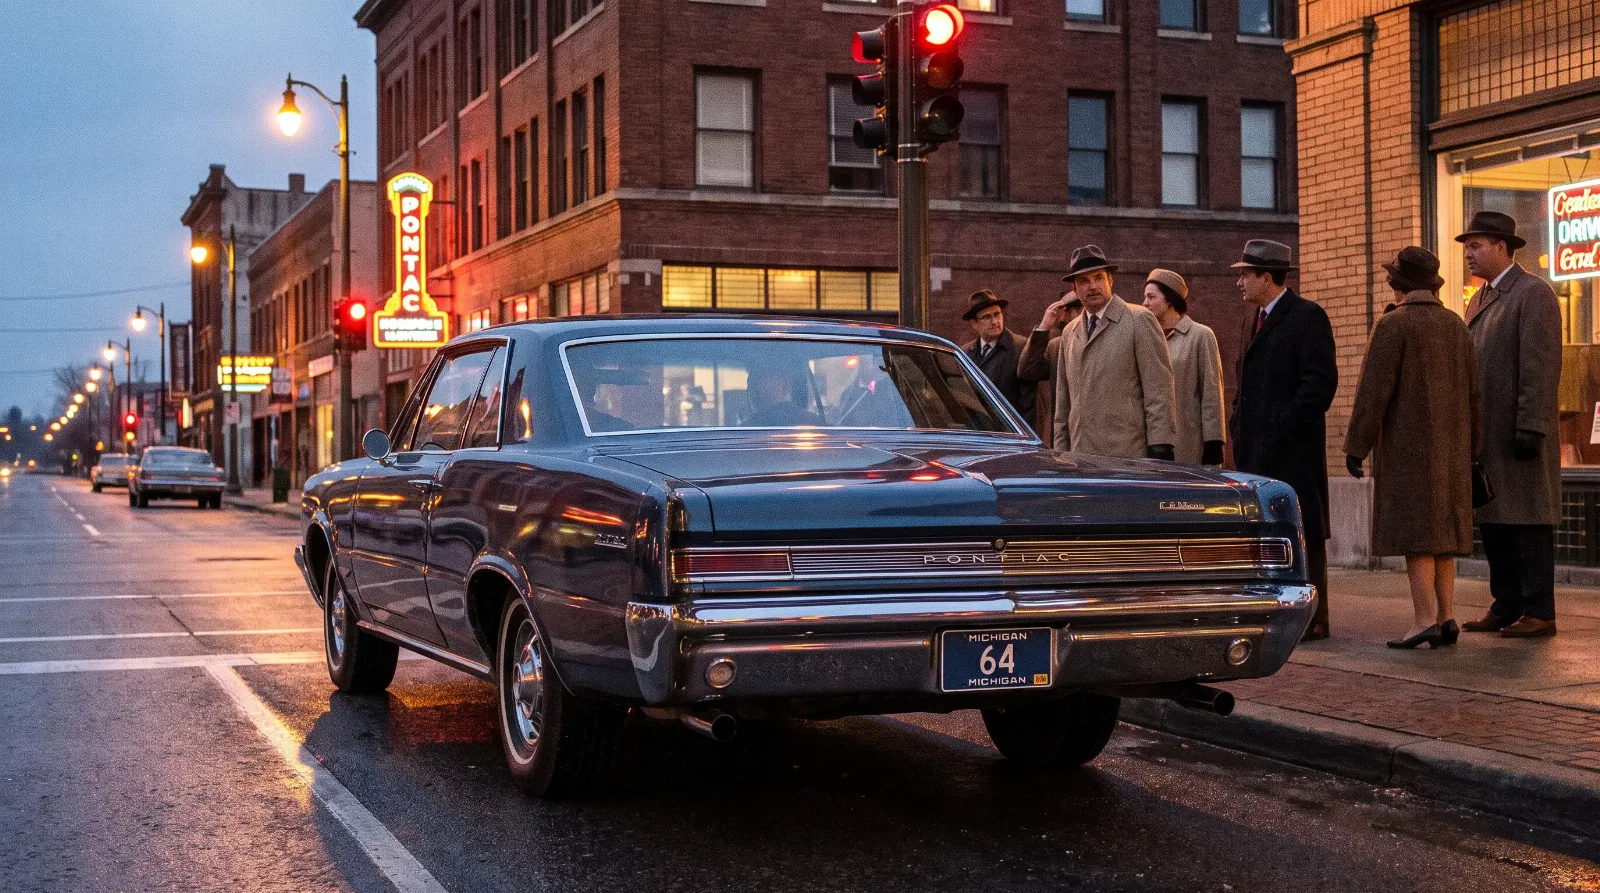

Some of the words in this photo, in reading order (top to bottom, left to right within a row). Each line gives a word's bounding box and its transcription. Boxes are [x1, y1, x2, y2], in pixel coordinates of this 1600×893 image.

[401, 196, 420, 312] PONTAC
[923, 553, 1069, 564] PONTIAC
[969, 632, 1027, 642] MICHIGAN
[980, 643, 1015, 675] 64
[968, 676, 1026, 687] MICHIGAN
